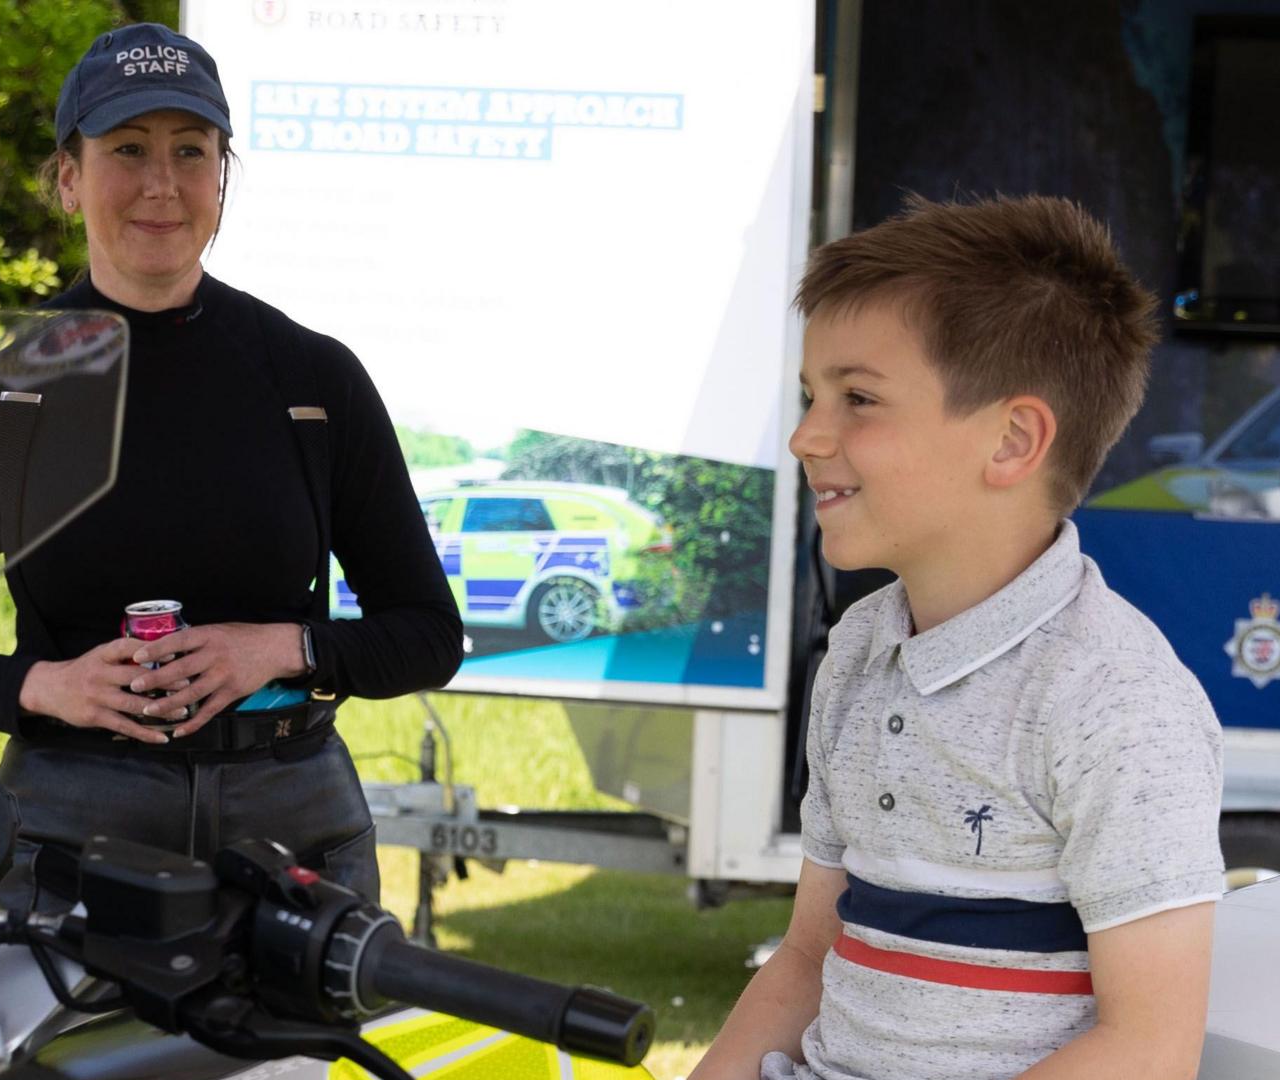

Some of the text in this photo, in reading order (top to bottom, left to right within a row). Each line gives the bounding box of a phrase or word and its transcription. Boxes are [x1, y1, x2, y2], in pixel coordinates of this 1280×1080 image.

[116, 45, 190, 64] POLICE
[123, 60, 187, 76] STAFF
[255, 84, 680, 128] SAFE SYSTEM APPROACH
[255, 118, 548, 158] TO ROAD SAFETY
[431, 823, 499, 855] 6103
